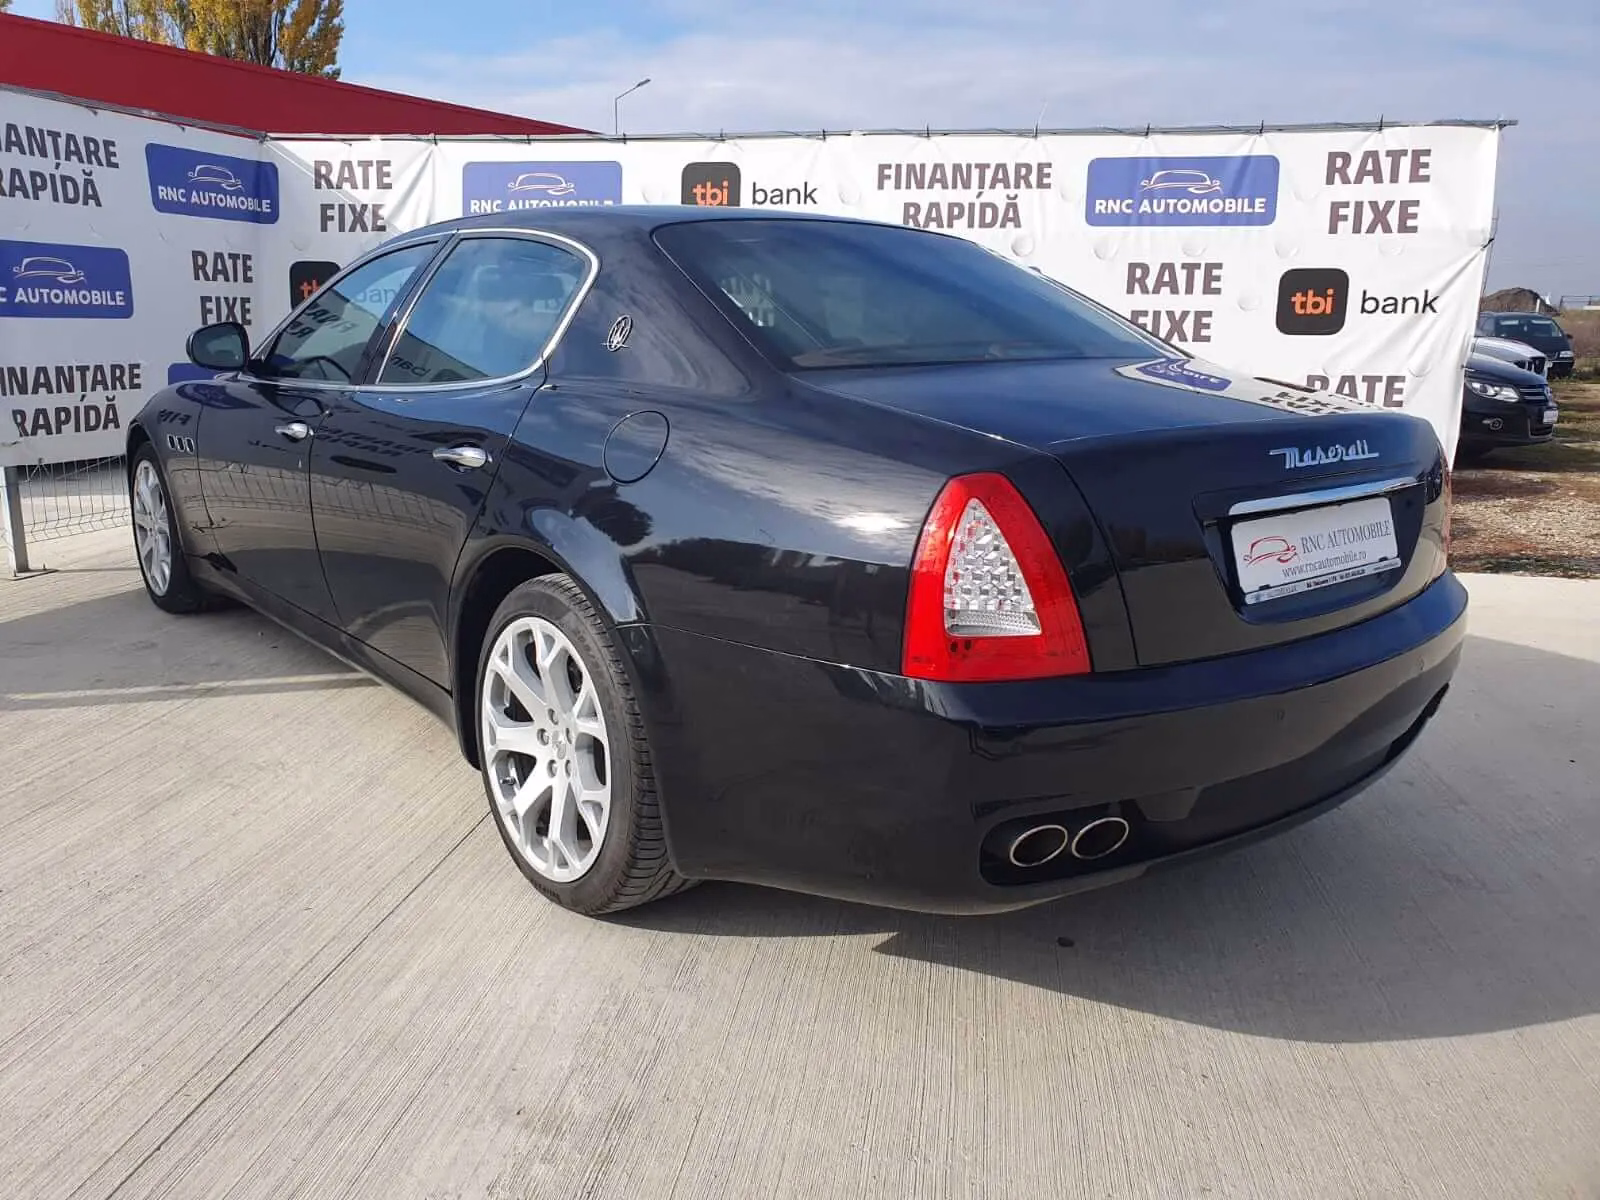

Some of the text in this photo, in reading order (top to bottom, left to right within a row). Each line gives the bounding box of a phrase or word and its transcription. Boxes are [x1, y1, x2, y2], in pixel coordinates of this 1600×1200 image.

[0, 123, 119, 169] ANȚARE
[314, 160, 392, 189] RATE
[1325, 149, 1431, 185] RATE
[158, 185, 271, 213] RNC AUTOMOBILE
[470, 200, 502, 213] RNC
[692, 180, 818, 205] tbi bank
[1095, 198, 1266, 214] RNC AUTOMOBILE
[320, 203, 386, 232] FIXE
[1328, 200, 1420, 234] FIXE
[192, 250, 253, 283] RATE
[1126, 262, 1223, 295] RATE
[14, 287, 125, 306] AUTOMOBILE
[200, 296, 252, 326] FIXE
[1290, 288, 1439, 315] tbi bank
[1129, 310, 1213, 343] FIXE
[1269, 439, 1379, 469] Maserati
[1300, 519, 1392, 554] RNC AUTOMOBILE
